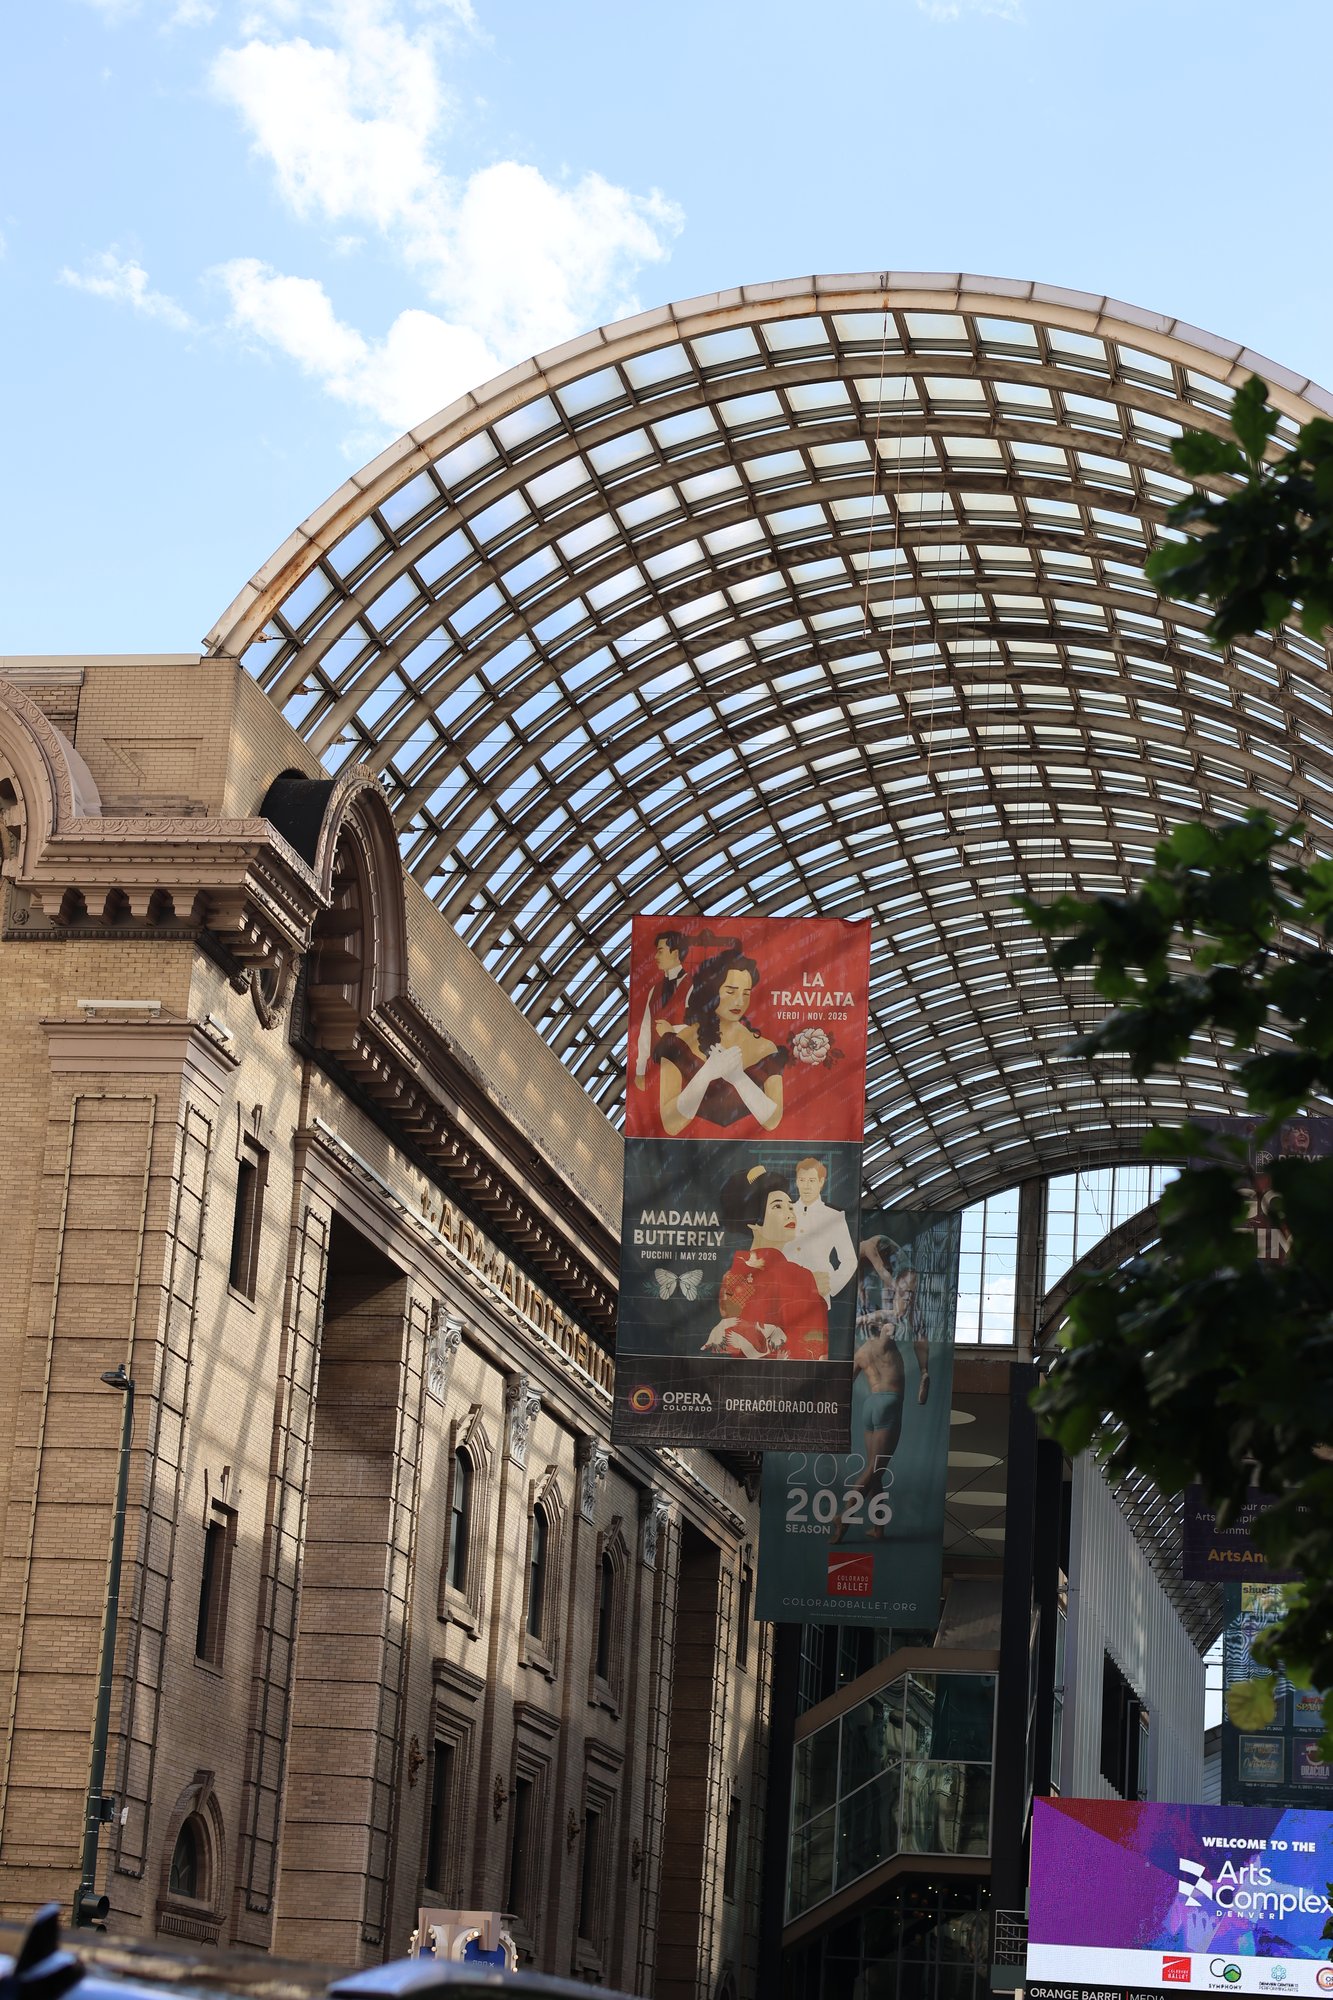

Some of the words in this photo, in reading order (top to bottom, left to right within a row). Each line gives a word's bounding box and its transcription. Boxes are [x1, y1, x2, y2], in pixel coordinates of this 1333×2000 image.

[802, 971, 824, 987] LA
[770, 990, 855, 1007] TRAVIATA
[777, 1011, 800, 1020] VERDI
[807, 1012, 825, 1021] NOV.
[827, 1012, 848, 1021] 2025
[640, 1209, 720, 1227] MADAMA
[633, 1228, 725, 1247] BUTTERFLY
[641, 1250, 672, 1260] PUCCINI
[680, 1251, 696, 1261] MAY
[698, 1252, 717, 1261] 2026
[662, 1391, 712, 1405] OPERA
[662, 1404, 712, 1413] COLORADO
[725, 1398, 838, 1414] OPERACOLORADO.ORG
[786, 1451, 895, 1489] 2025
[785, 1487, 893, 1526] 2026
[1195, 1512, 1215, 1522] Arts
[785, 1523, 831, 1535] SEASON
[1207, 1548, 1268, 1563] ArtsAn
[836, 1574, 869, 1583] COLORADO
[836, 1582, 869, 1592] BALLET
[782, 1597, 917, 1612] COLORADOBALLET.ORG
[1300, 1765, 1330, 1777] DRACULA
[1202, 1836, 1267, 1850] WELCOME
[1270, 1840, 1288, 1851] TO
[1292, 1842, 1316, 1853] THE
[1216, 1860, 1271, 1886] Arts
[1215, 1885, 1333, 1920] Complex
[1216, 1910, 1275, 1920] DENVER
[1030, 1987, 1079, 2000] ORANGE
[1082, 1991, 1122, 2000] BARREL
